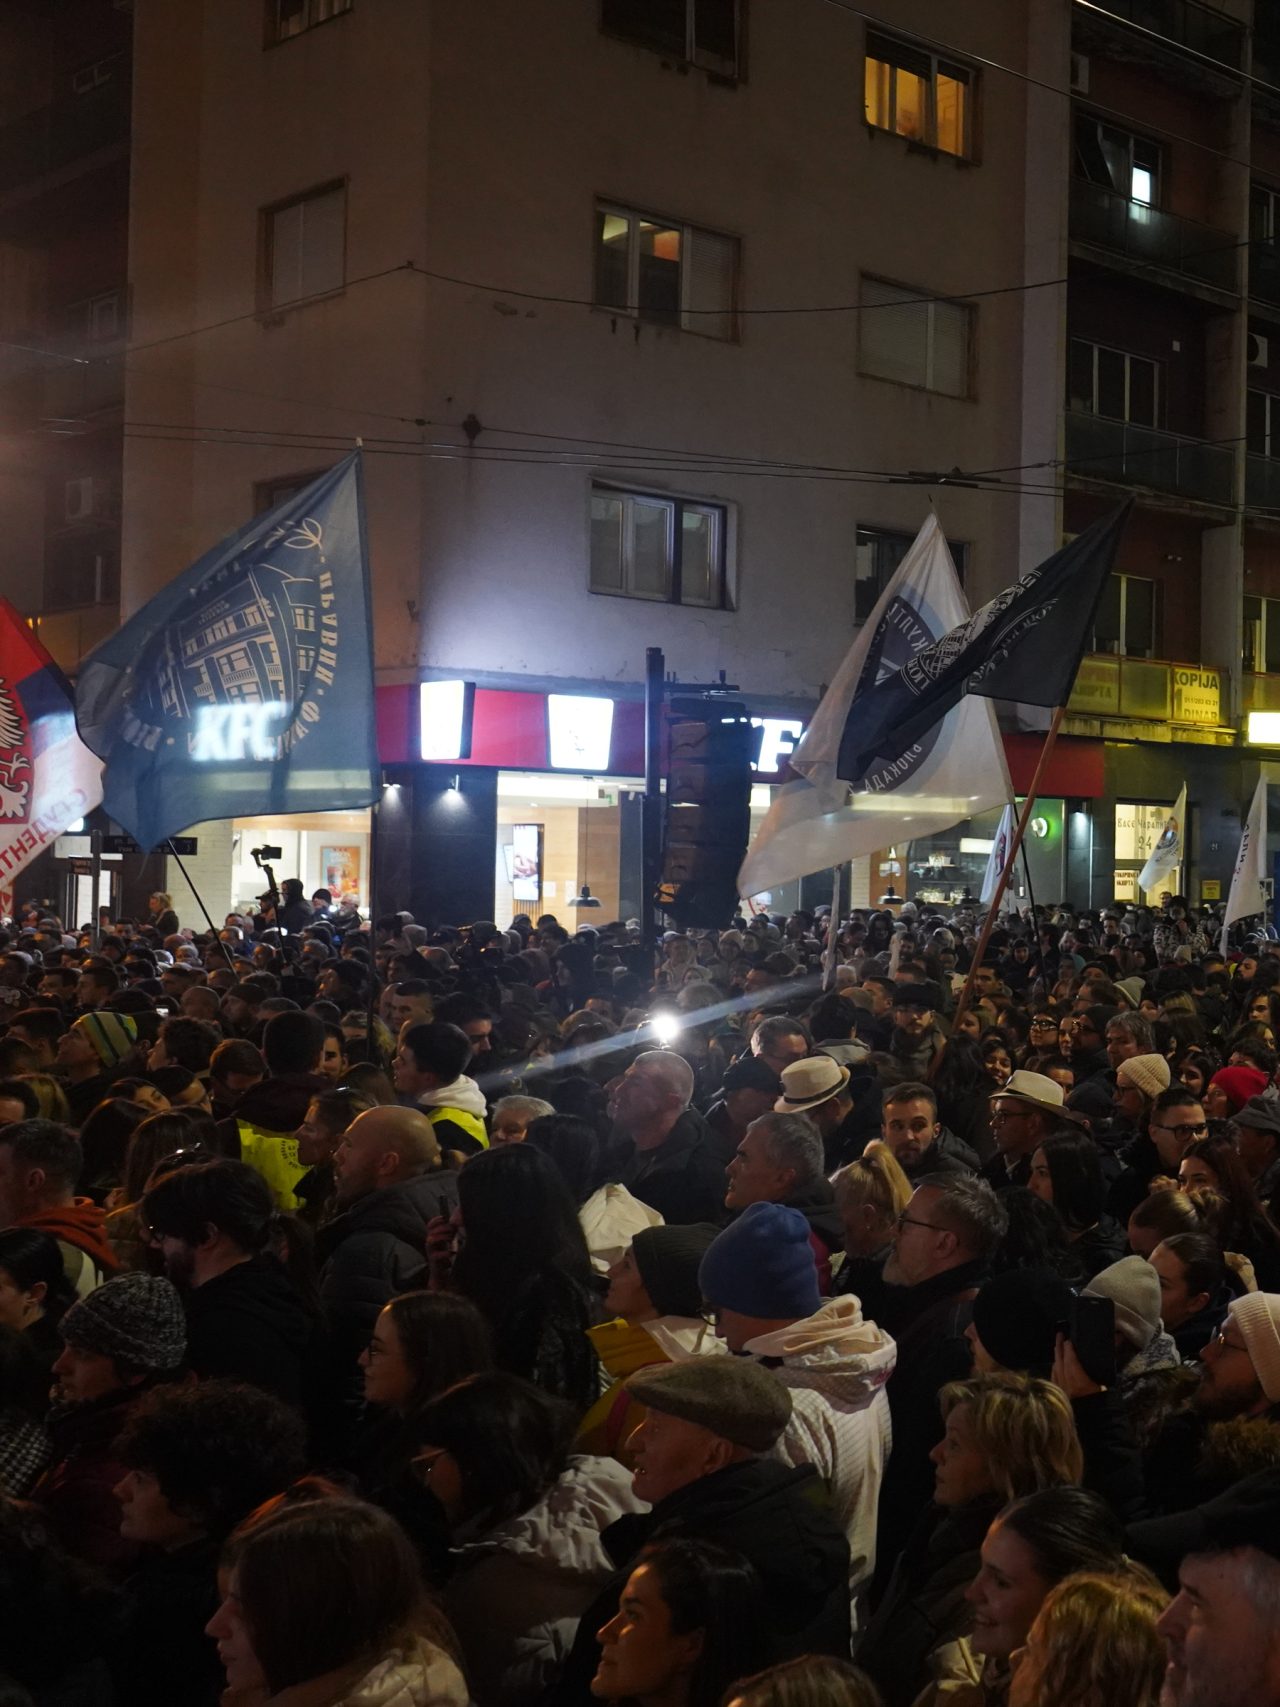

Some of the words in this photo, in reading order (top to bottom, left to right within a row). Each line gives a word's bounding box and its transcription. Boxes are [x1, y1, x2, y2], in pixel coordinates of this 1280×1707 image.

[1174, 671, 1218, 690] KOPIJA
[1183, 708, 1218, 721] DINAR
[193, 701, 286, 761] KFC
[1138, 836, 1151, 850] 24
